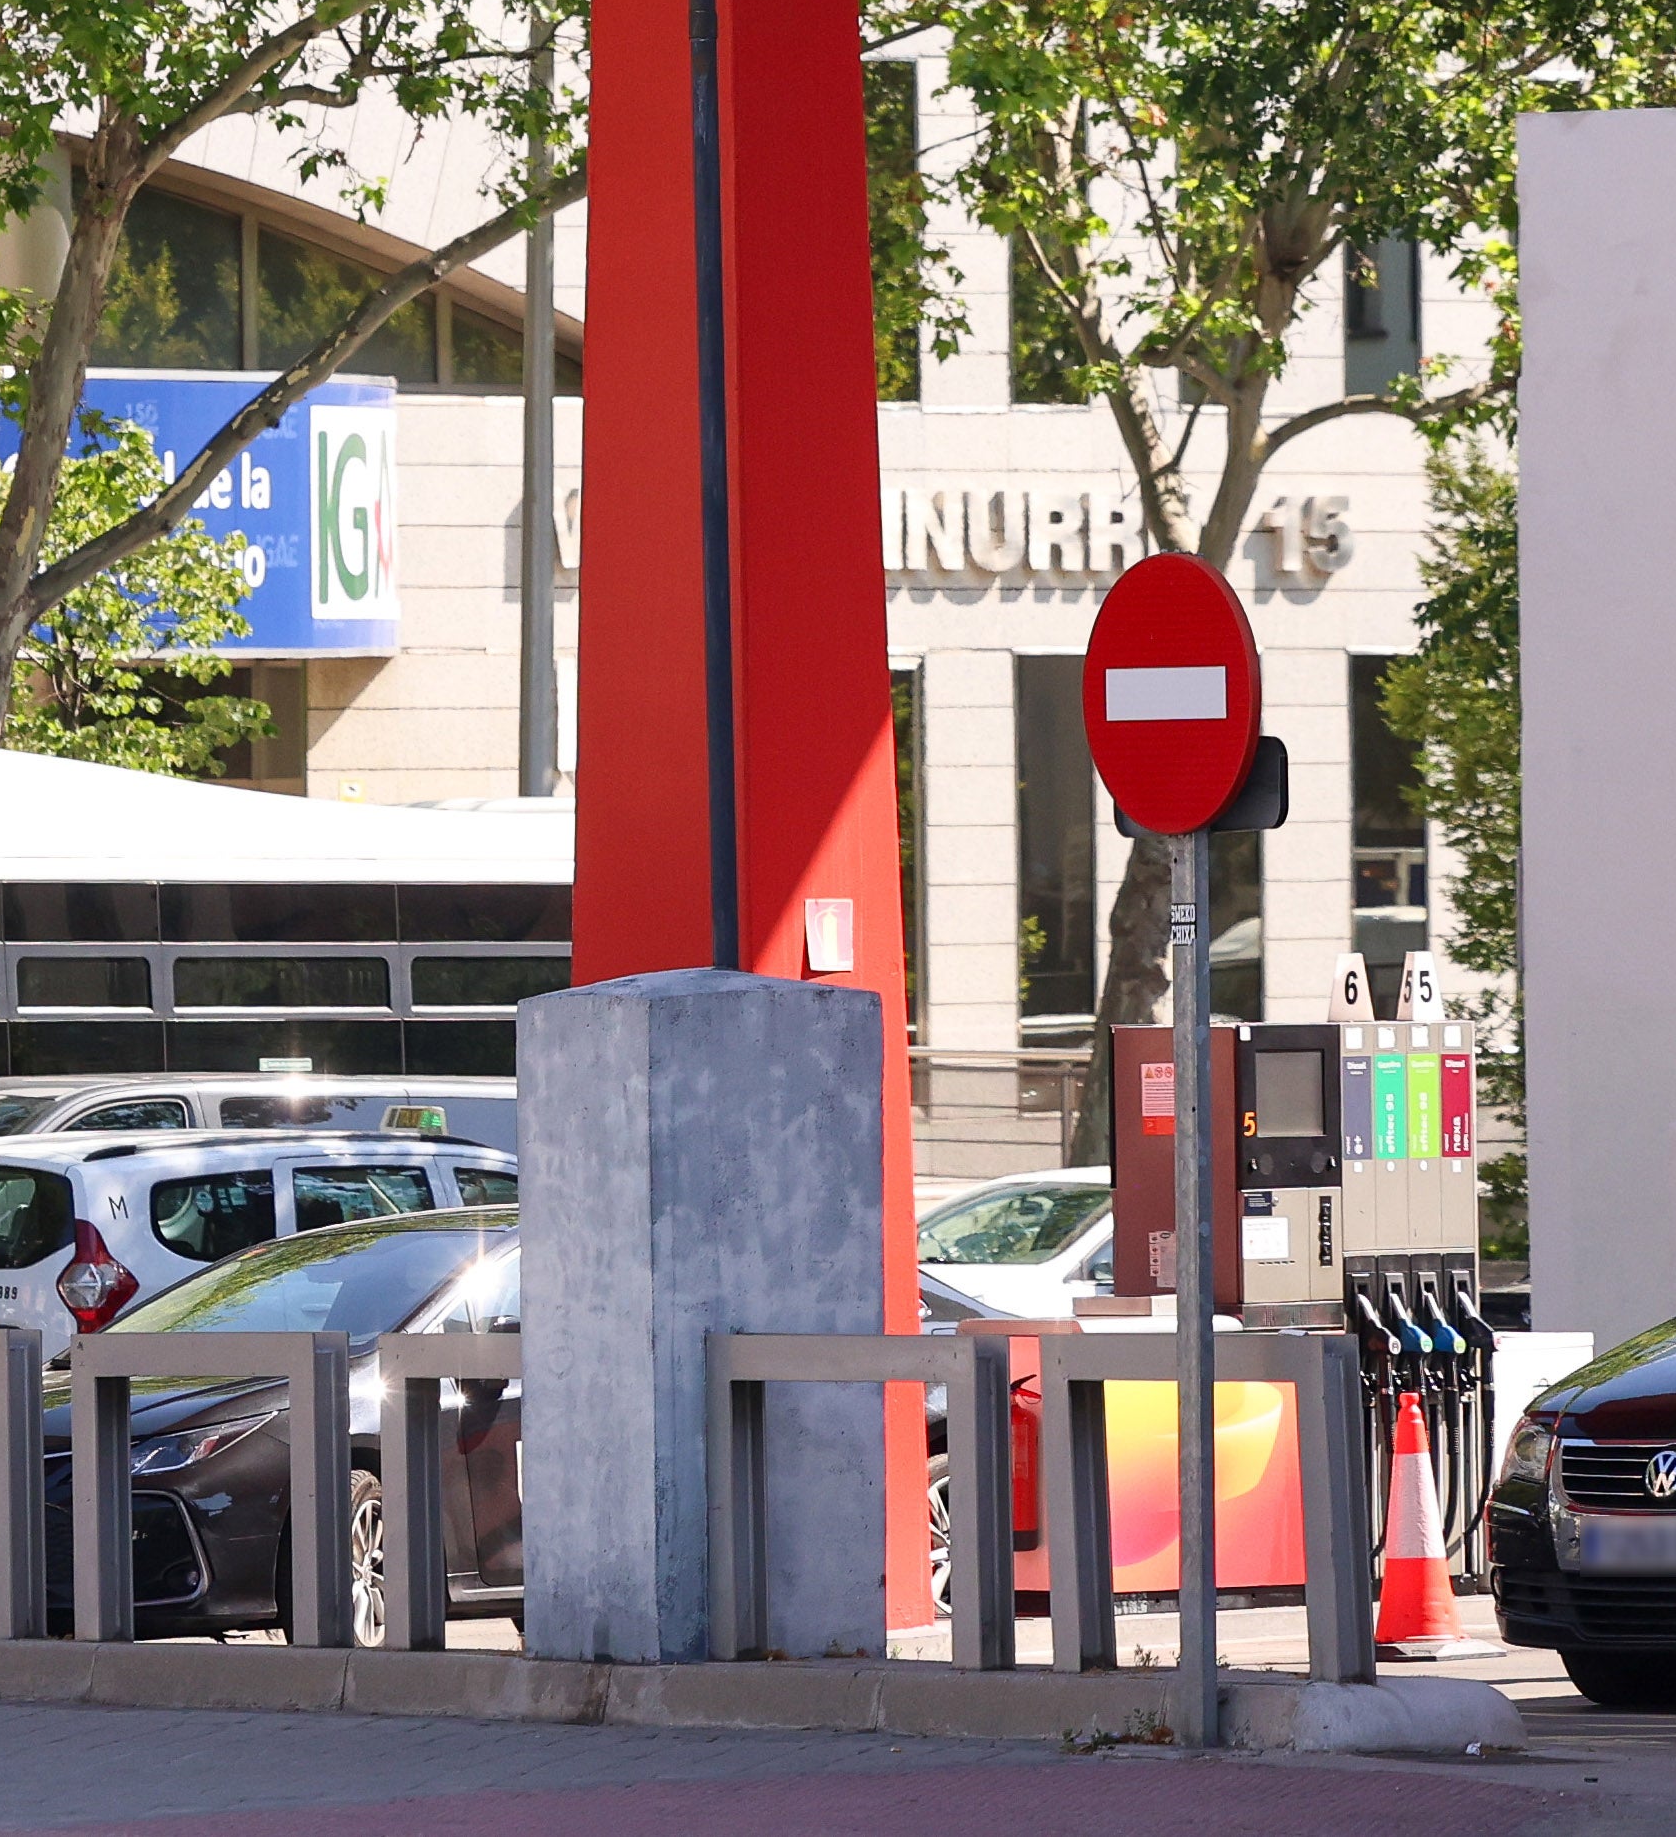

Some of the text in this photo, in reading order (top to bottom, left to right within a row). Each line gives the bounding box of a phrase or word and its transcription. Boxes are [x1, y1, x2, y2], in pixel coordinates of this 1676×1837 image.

[242, 452, 271, 509] la
[882, 491, 1357, 573] INURR 15
[1345, 971, 1358, 1005] 6
[1404, 970, 1413, 1003] 5
[1420, 970, 1432, 1003] 5
[1244, 1111, 1257, 1137] 5
[108, 1195, 129, 1220] M
